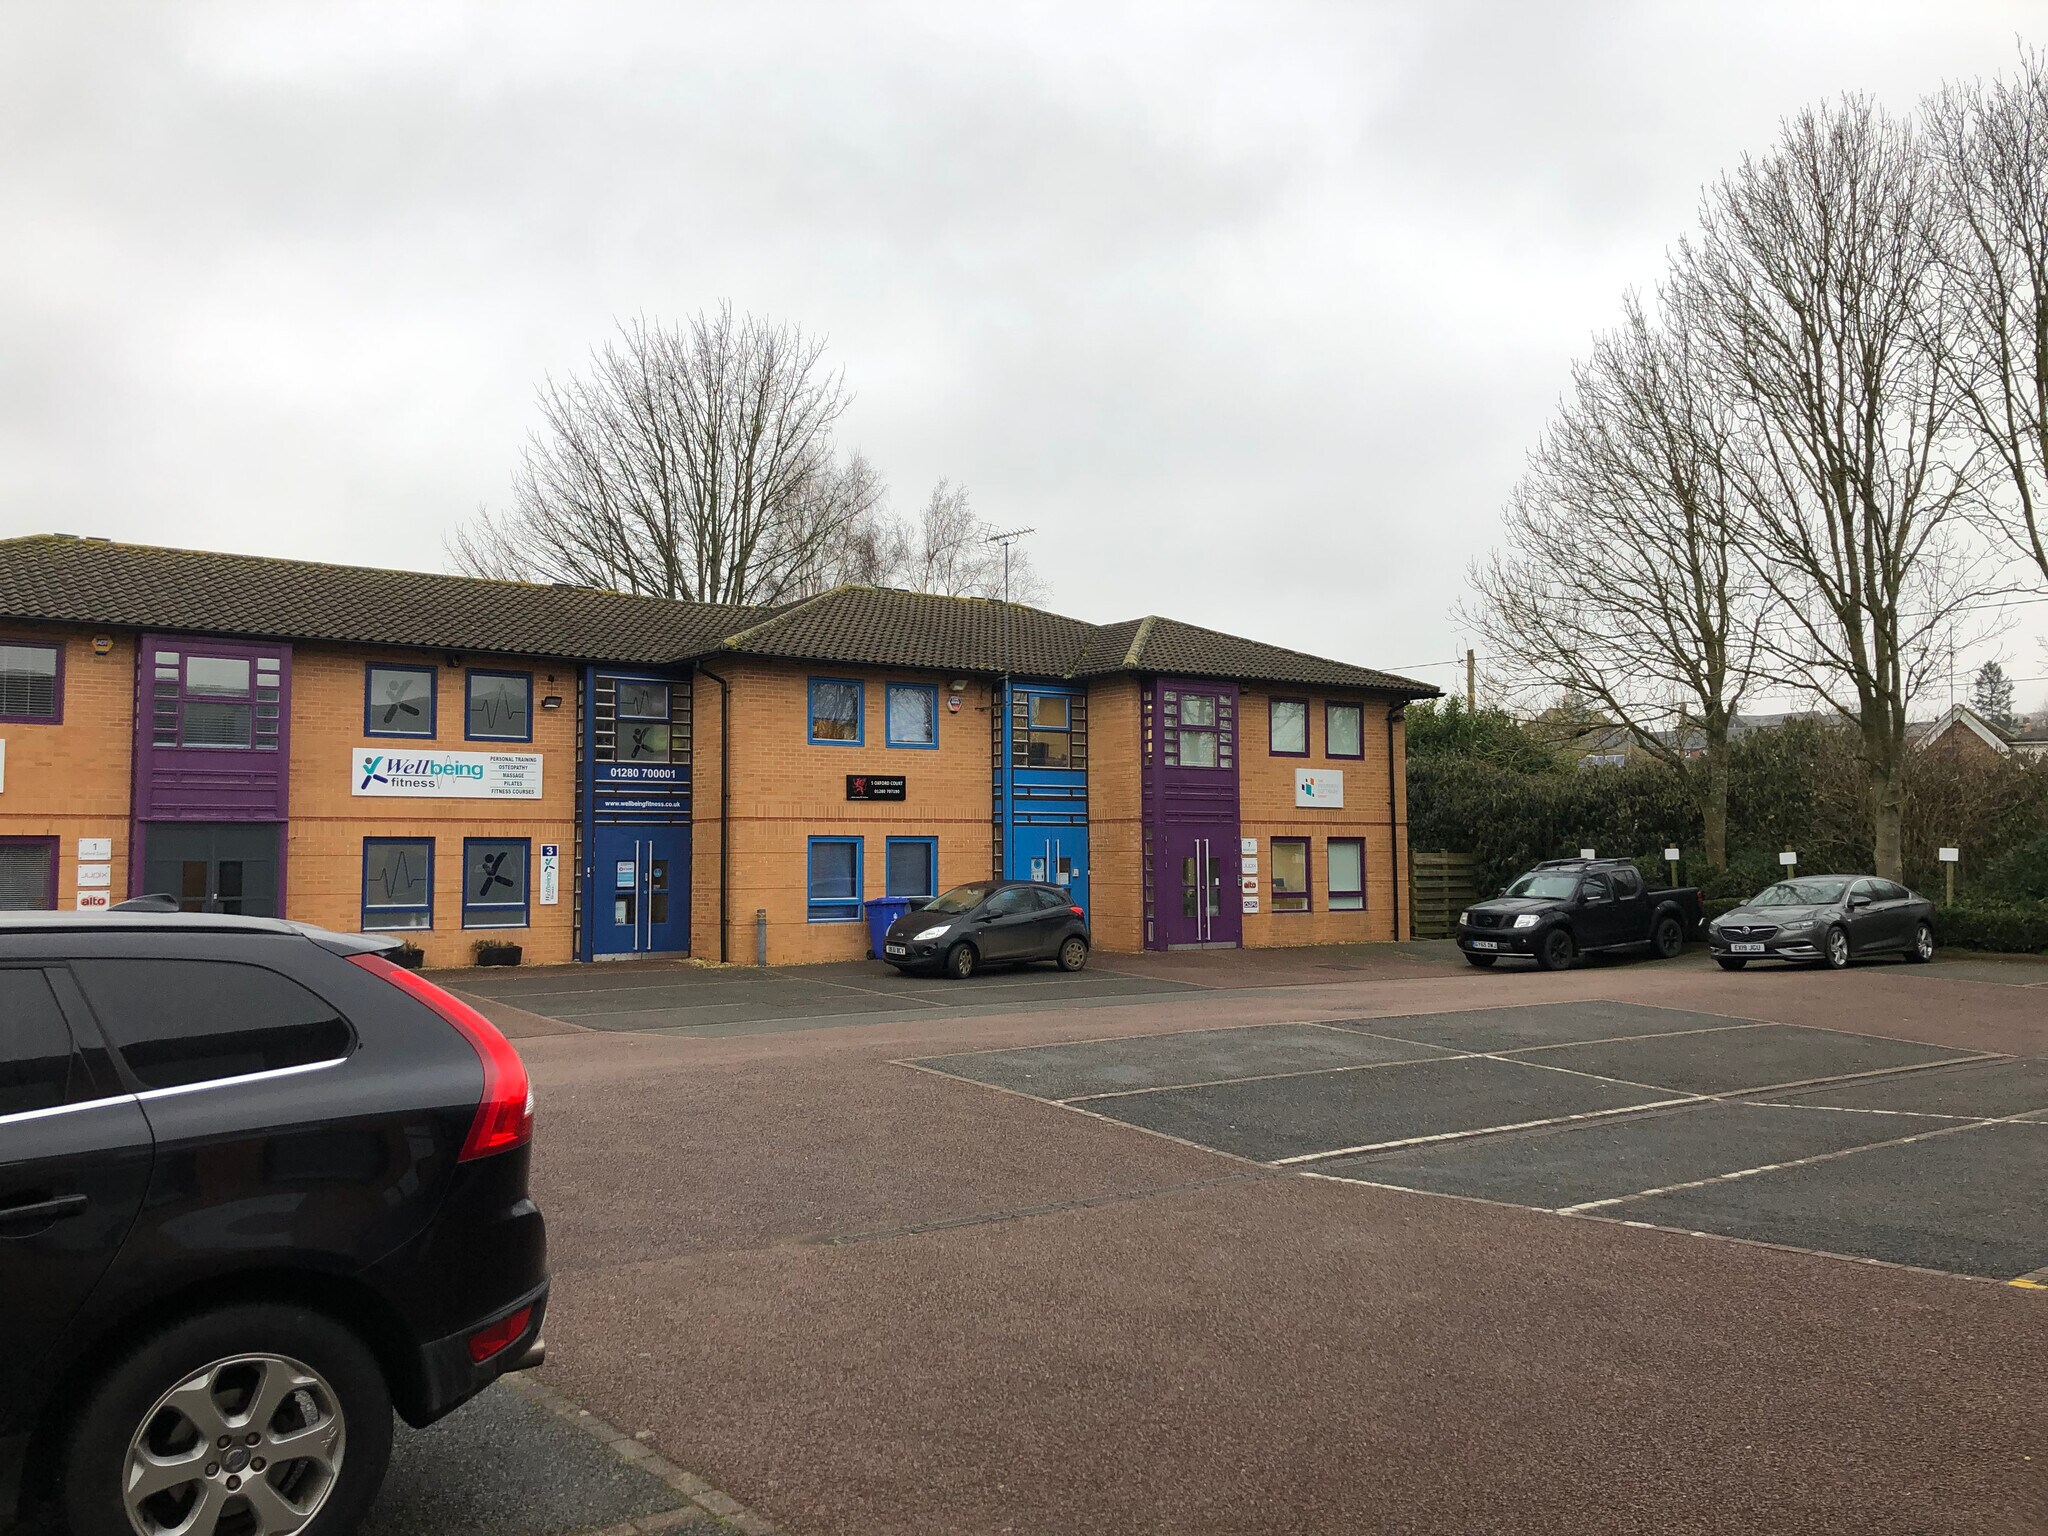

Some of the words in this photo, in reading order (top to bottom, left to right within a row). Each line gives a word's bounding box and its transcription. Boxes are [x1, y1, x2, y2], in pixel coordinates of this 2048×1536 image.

[387, 759, 484, 780] Wellbeing
[610, 767, 639, 778] 01280
[641, 768, 676, 779] 700001
[391, 777, 436, 788] fitness
[604, 800, 681, 808] www.wellbeingfitness.co.uk
[546, 846, 554, 856] 3
[80, 896, 106, 906] alto
